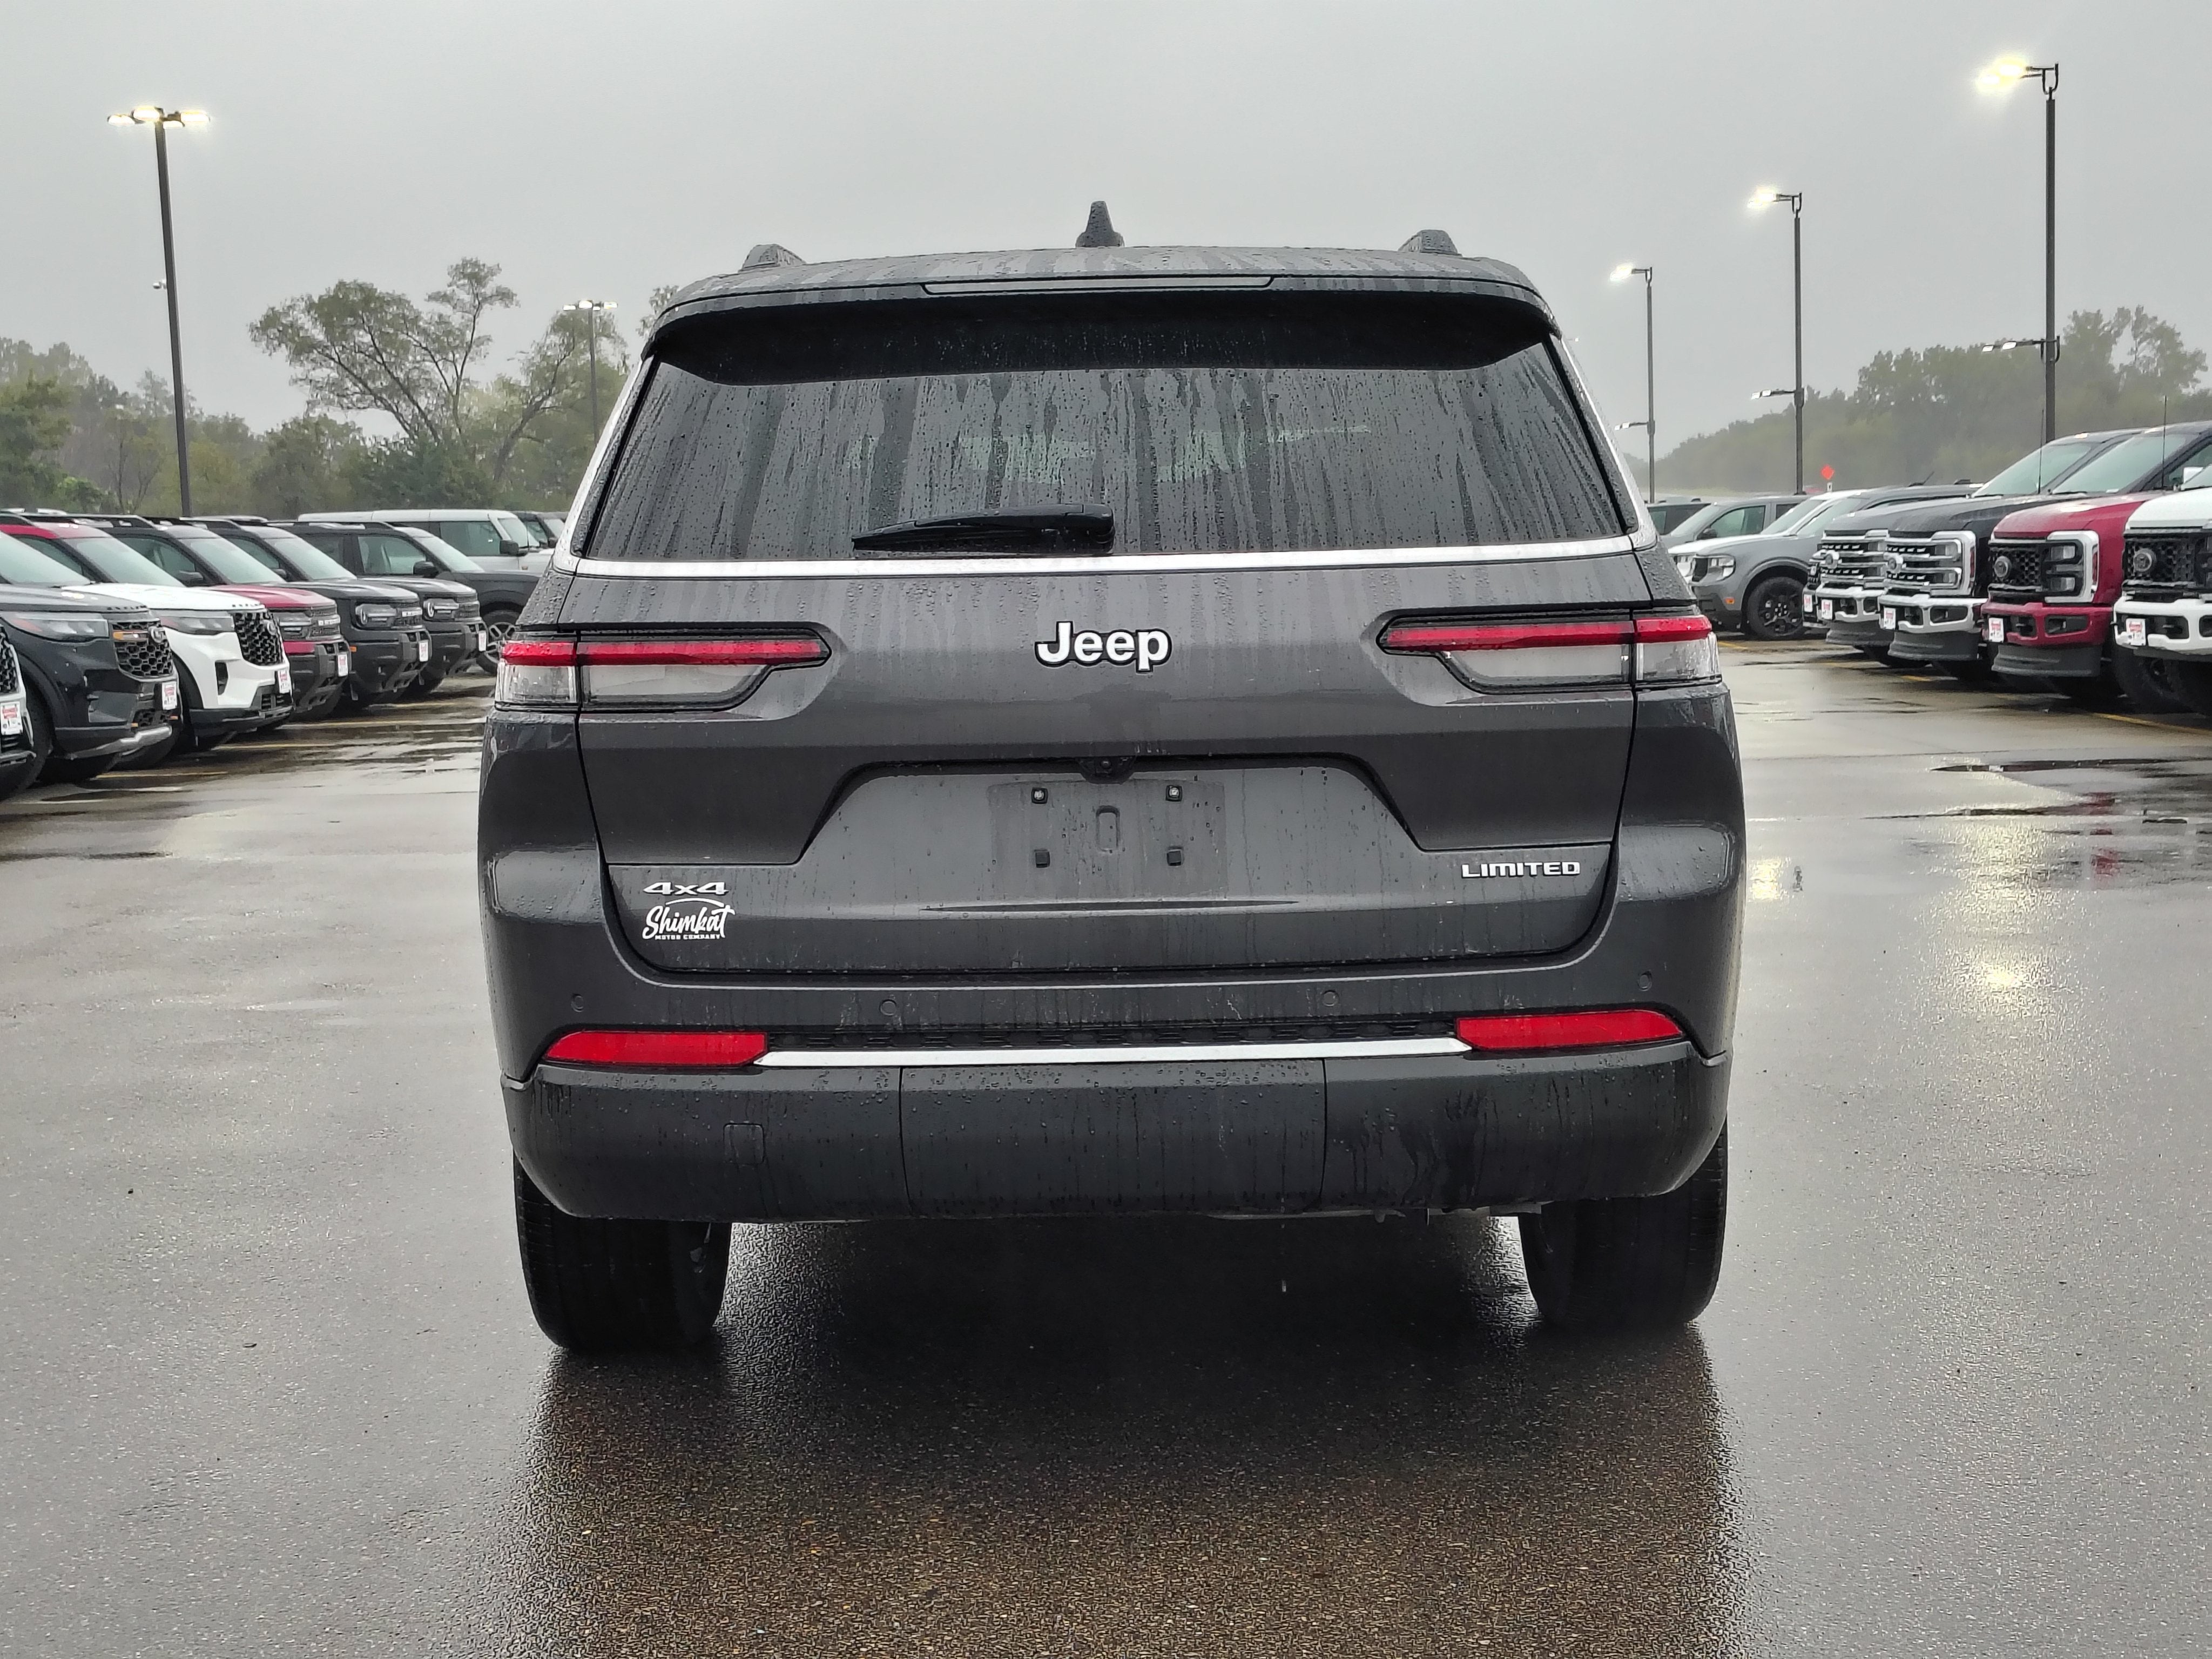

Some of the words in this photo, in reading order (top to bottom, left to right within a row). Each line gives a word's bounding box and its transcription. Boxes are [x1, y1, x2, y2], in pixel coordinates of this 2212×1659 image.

[1035, 621, 1171, 672] Jeep
[1461, 862, 1581, 878] LIMITED
[642, 904, 736, 940] Shimkat
